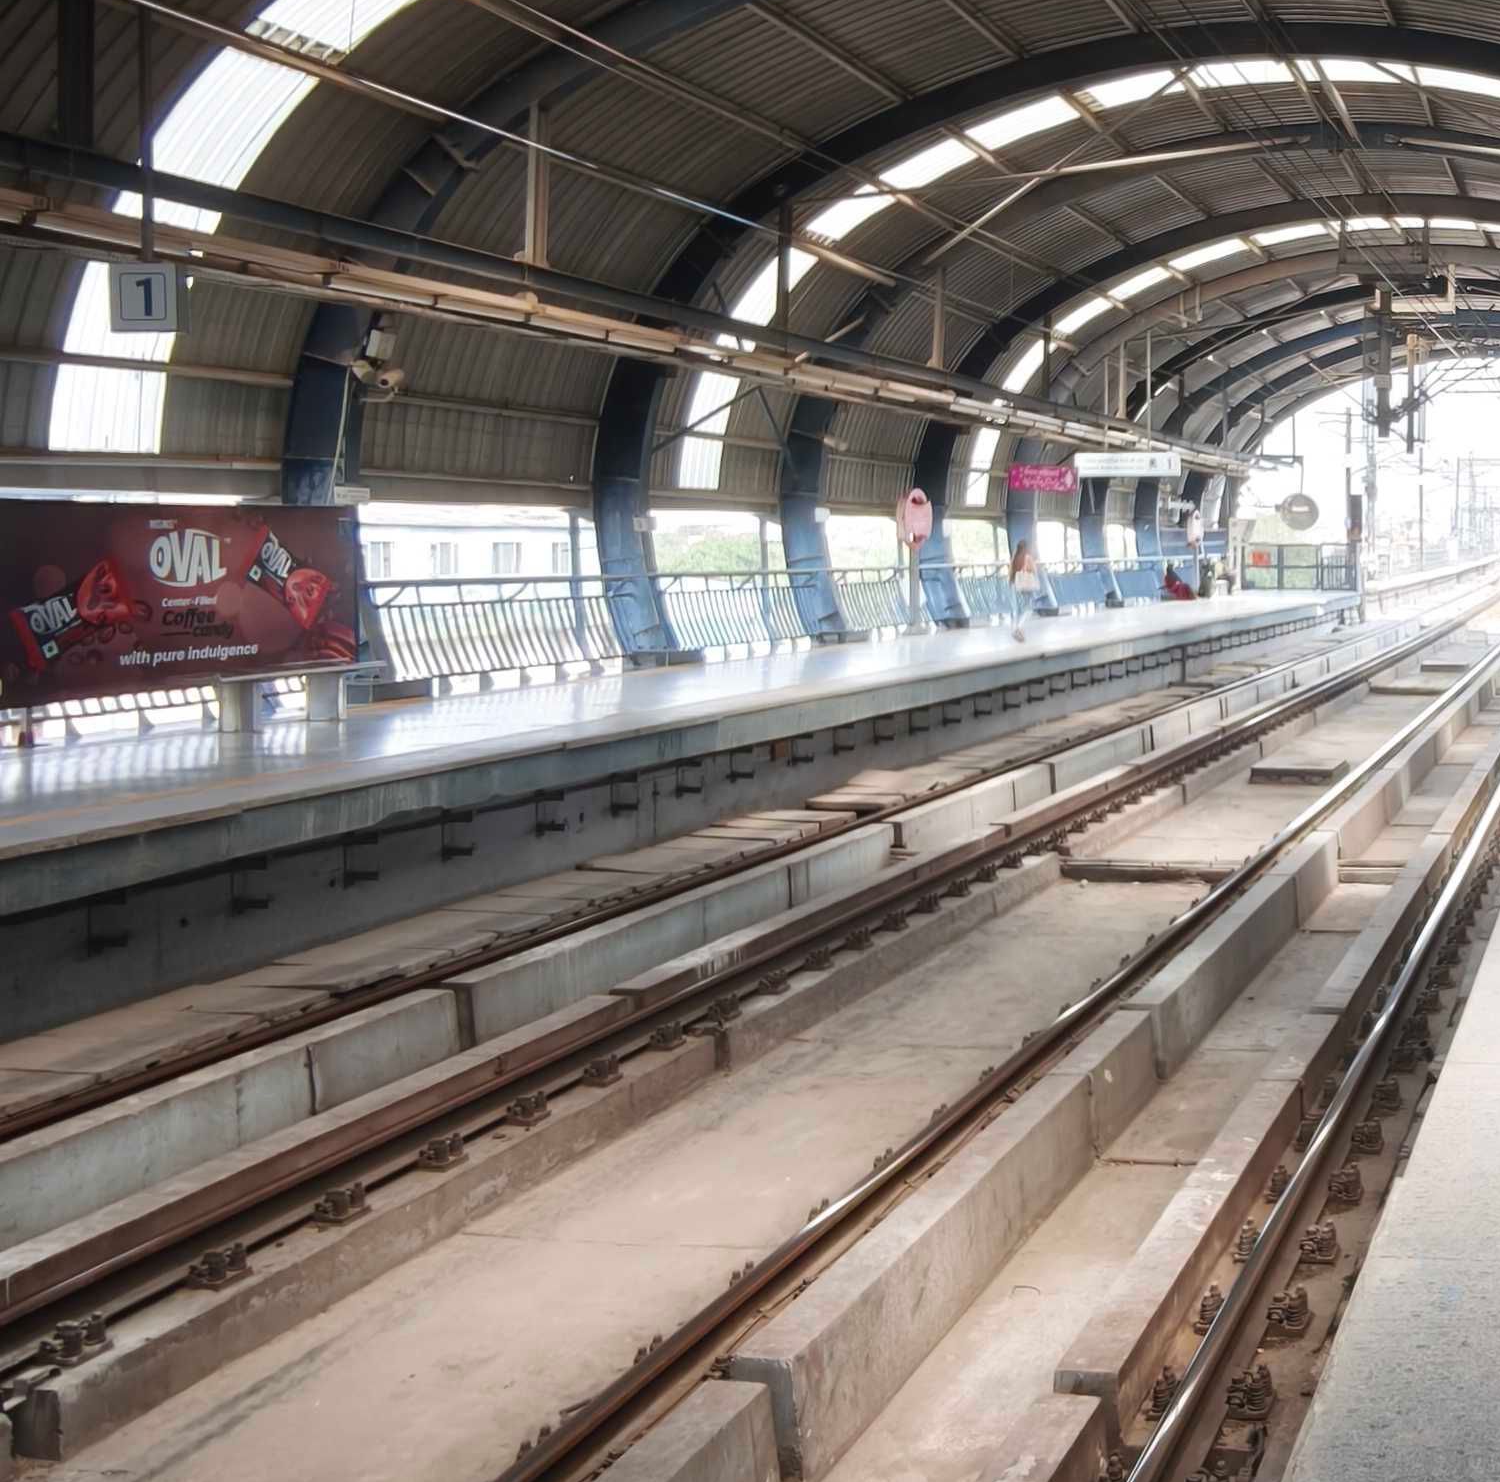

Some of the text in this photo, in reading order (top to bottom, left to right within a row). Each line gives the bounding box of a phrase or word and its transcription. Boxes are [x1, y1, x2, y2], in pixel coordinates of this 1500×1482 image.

[136, 277, 153, 316] 1
[150, 528, 228, 588] OVAL
[261, 534, 292, 578] OVAL
[26, 597, 78, 633] OVAL
[163, 608, 216, 629] Coffee
[119, 643, 259, 666] with pure indulgence
